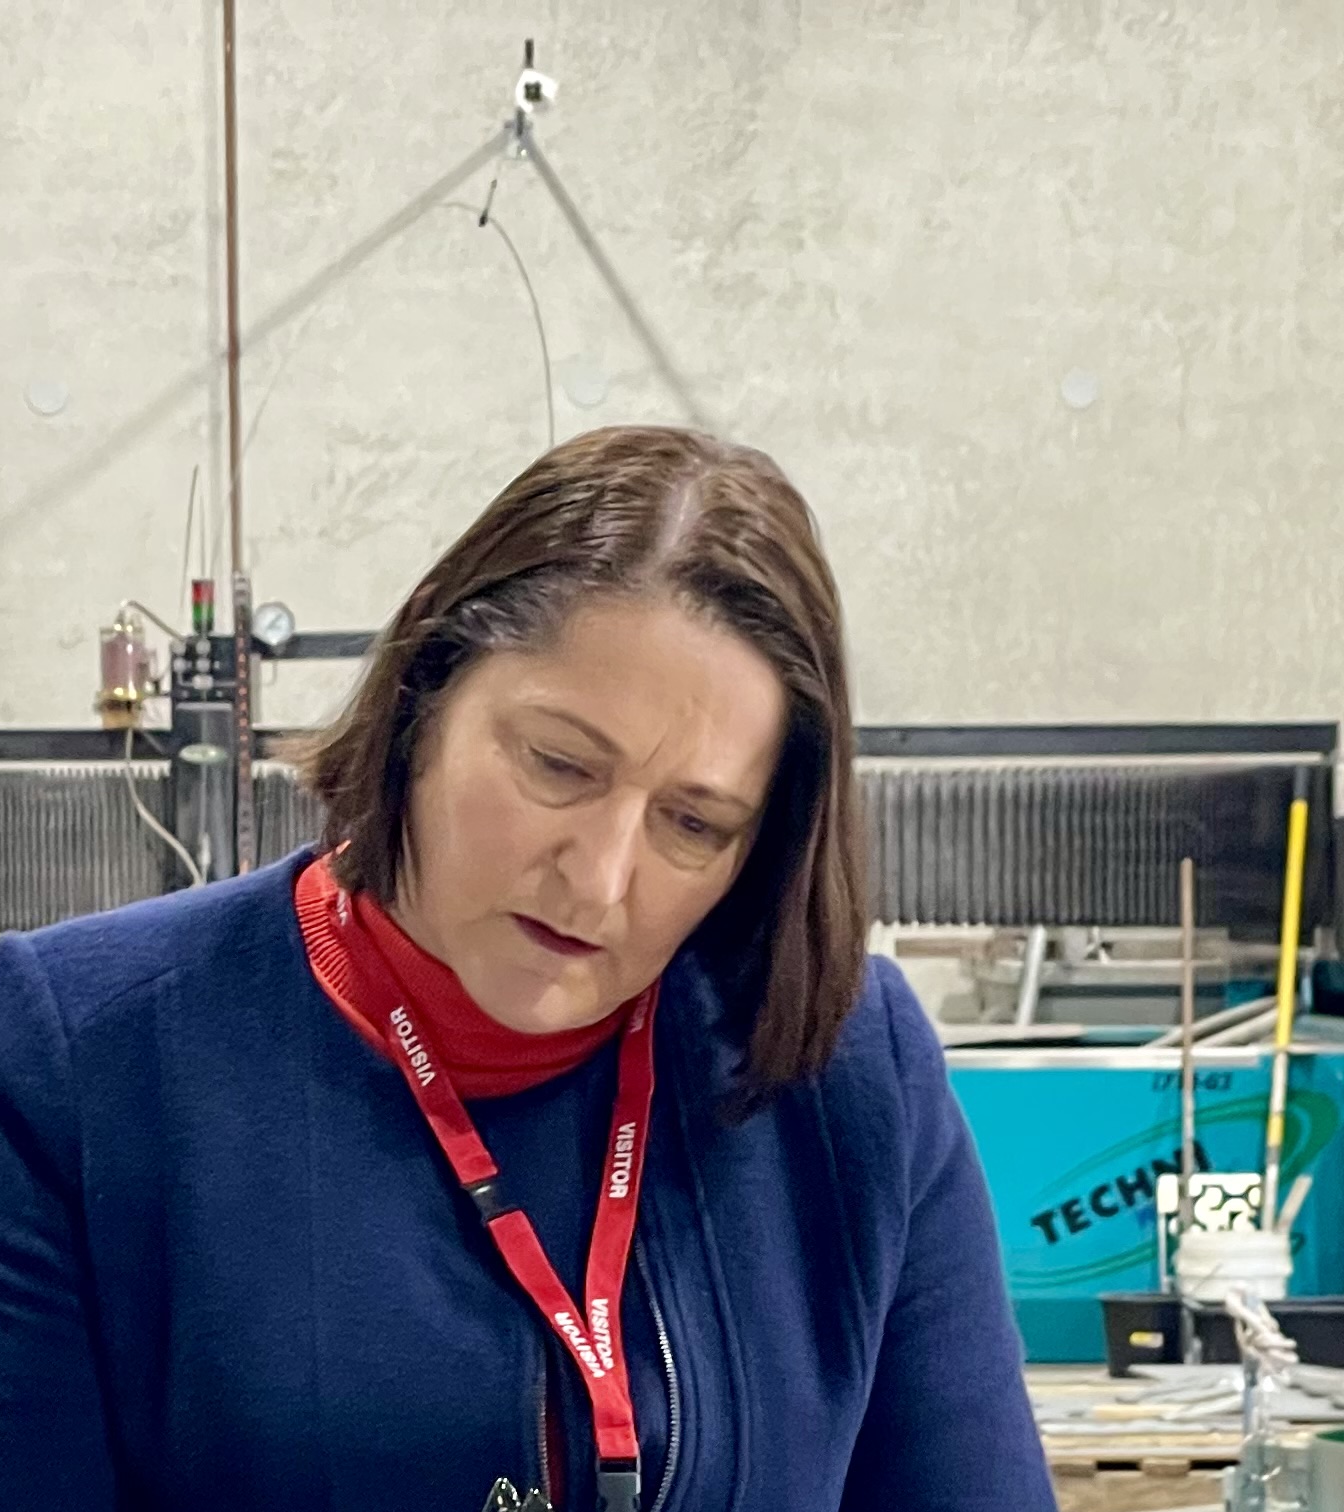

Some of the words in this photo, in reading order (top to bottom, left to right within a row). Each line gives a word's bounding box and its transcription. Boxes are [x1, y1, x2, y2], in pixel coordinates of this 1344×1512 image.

[390, 1005, 434, 1087] VISITOR
[608, 1121, 637, 1199] VISITOR
[554, 1311, 607, 1378] VISITOR
